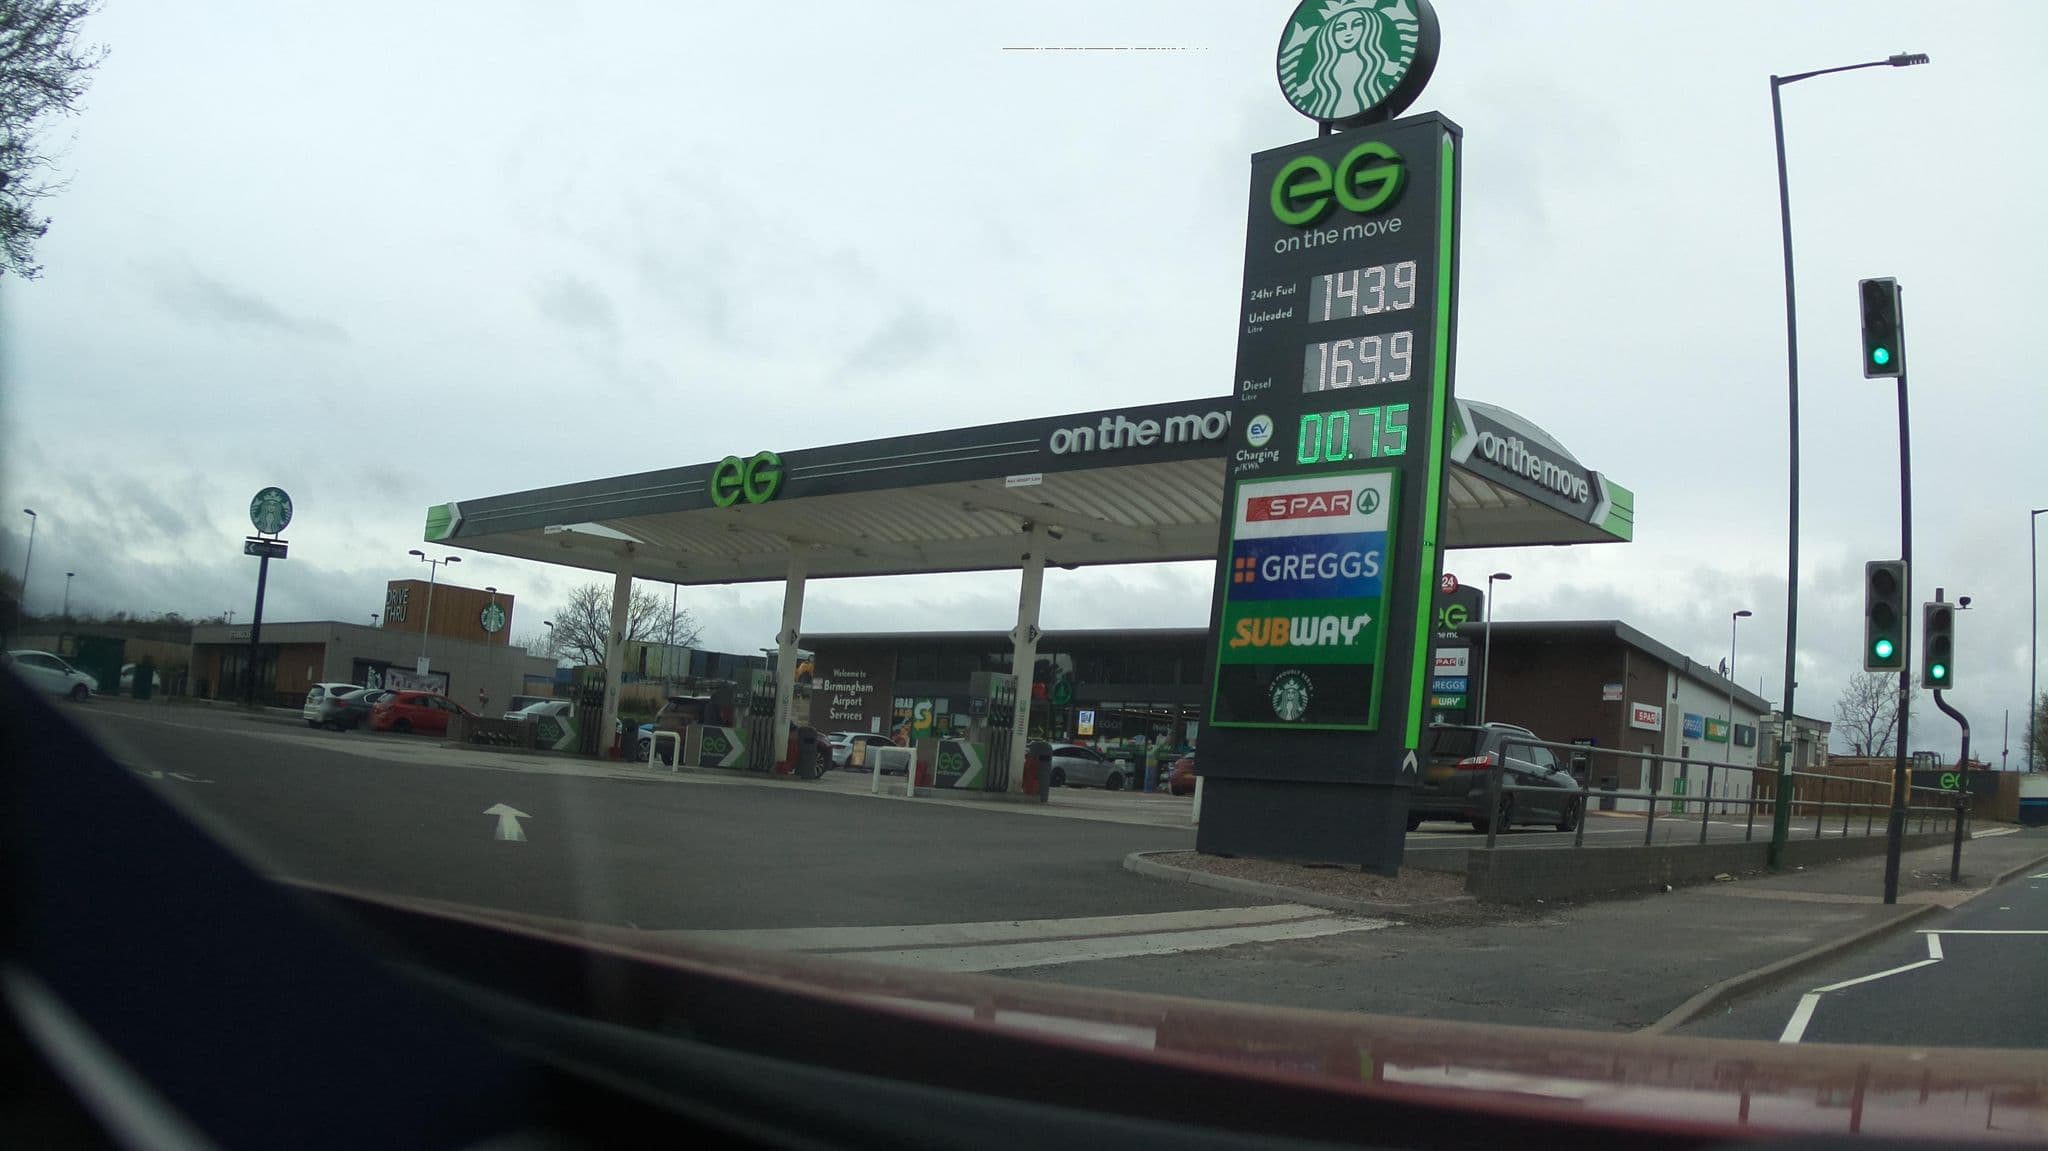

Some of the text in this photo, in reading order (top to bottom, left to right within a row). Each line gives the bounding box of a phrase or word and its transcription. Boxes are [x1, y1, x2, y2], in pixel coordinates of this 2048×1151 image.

[1274, 217, 1402, 253] on the move
[1250, 283, 1296, 301] 24hr Fuel
[1323, 260, 1417, 321] 143.9
[1249, 308, 1293, 324] Unleaded
[1247, 325, 1263, 334] Litre
[1318, 330, 1413, 391] 169.9
[1243, 378, 1272, 391] Diesel
[1049, 410, 1231, 455] on the mo
[1297, 403, 1409, 465] 00.75
[1236, 448, 1280, 463] Charging
[1478, 431, 1588, 503] on the move
[1269, 493, 1350, 516] SPAR
[1262, 551, 1380, 582] GREGGS
[1442, 577, 1454, 588] 24
[386, 588, 410, 606] DRIVE
[385, 604, 408, 624] THRU
[1229, 613, 1372, 649] SUBWAY
[1436, 657, 1457, 667] PAR
[833, 669, 859, 677] Welcome
[823, 679, 874, 696] Birmingham
[832, 694, 863, 710] Airport
[1431, 696, 1460, 706] WAY
[829, 708, 863, 721] Services
[1637, 711, 1656, 724] SPAR
